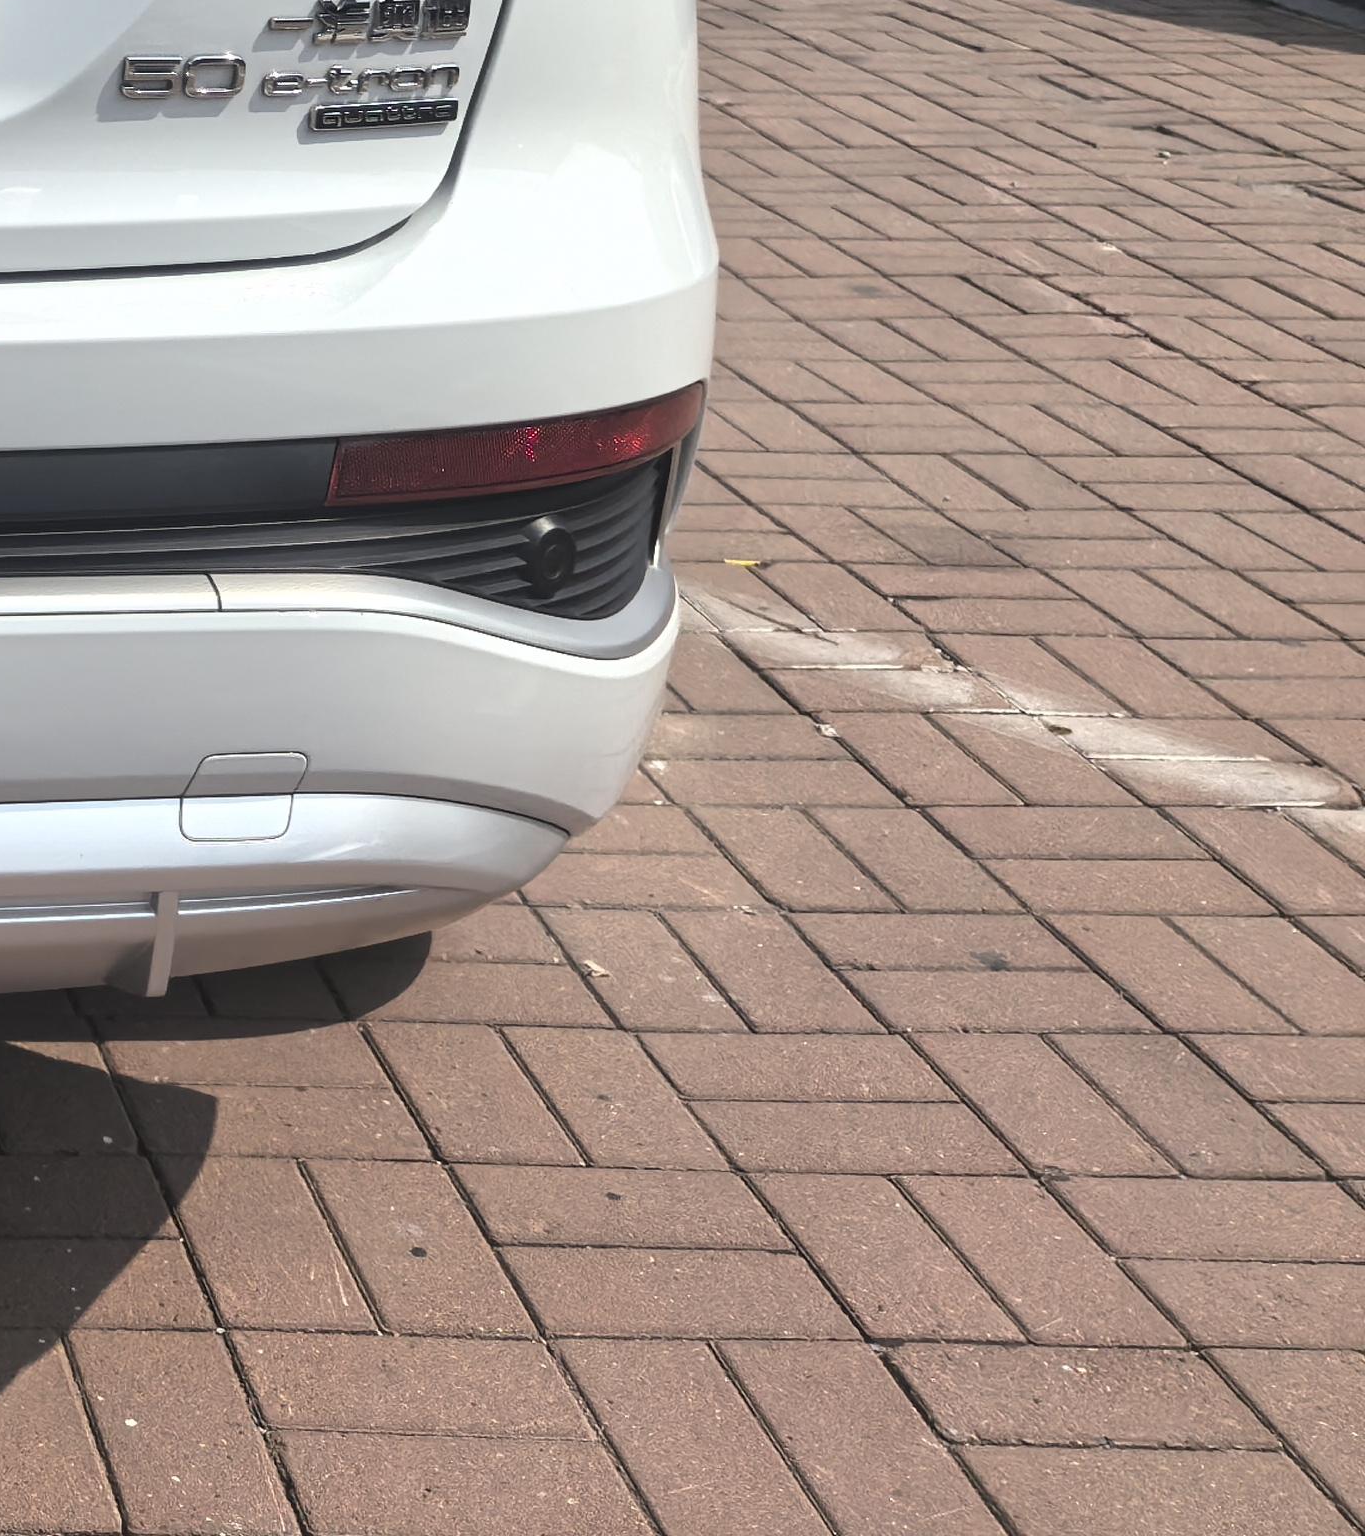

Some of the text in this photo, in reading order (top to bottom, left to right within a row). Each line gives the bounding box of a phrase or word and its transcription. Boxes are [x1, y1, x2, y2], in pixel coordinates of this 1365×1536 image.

[120, 55, 460, 99] 50 e-tron
[321, 102, 455, 127] quattro
